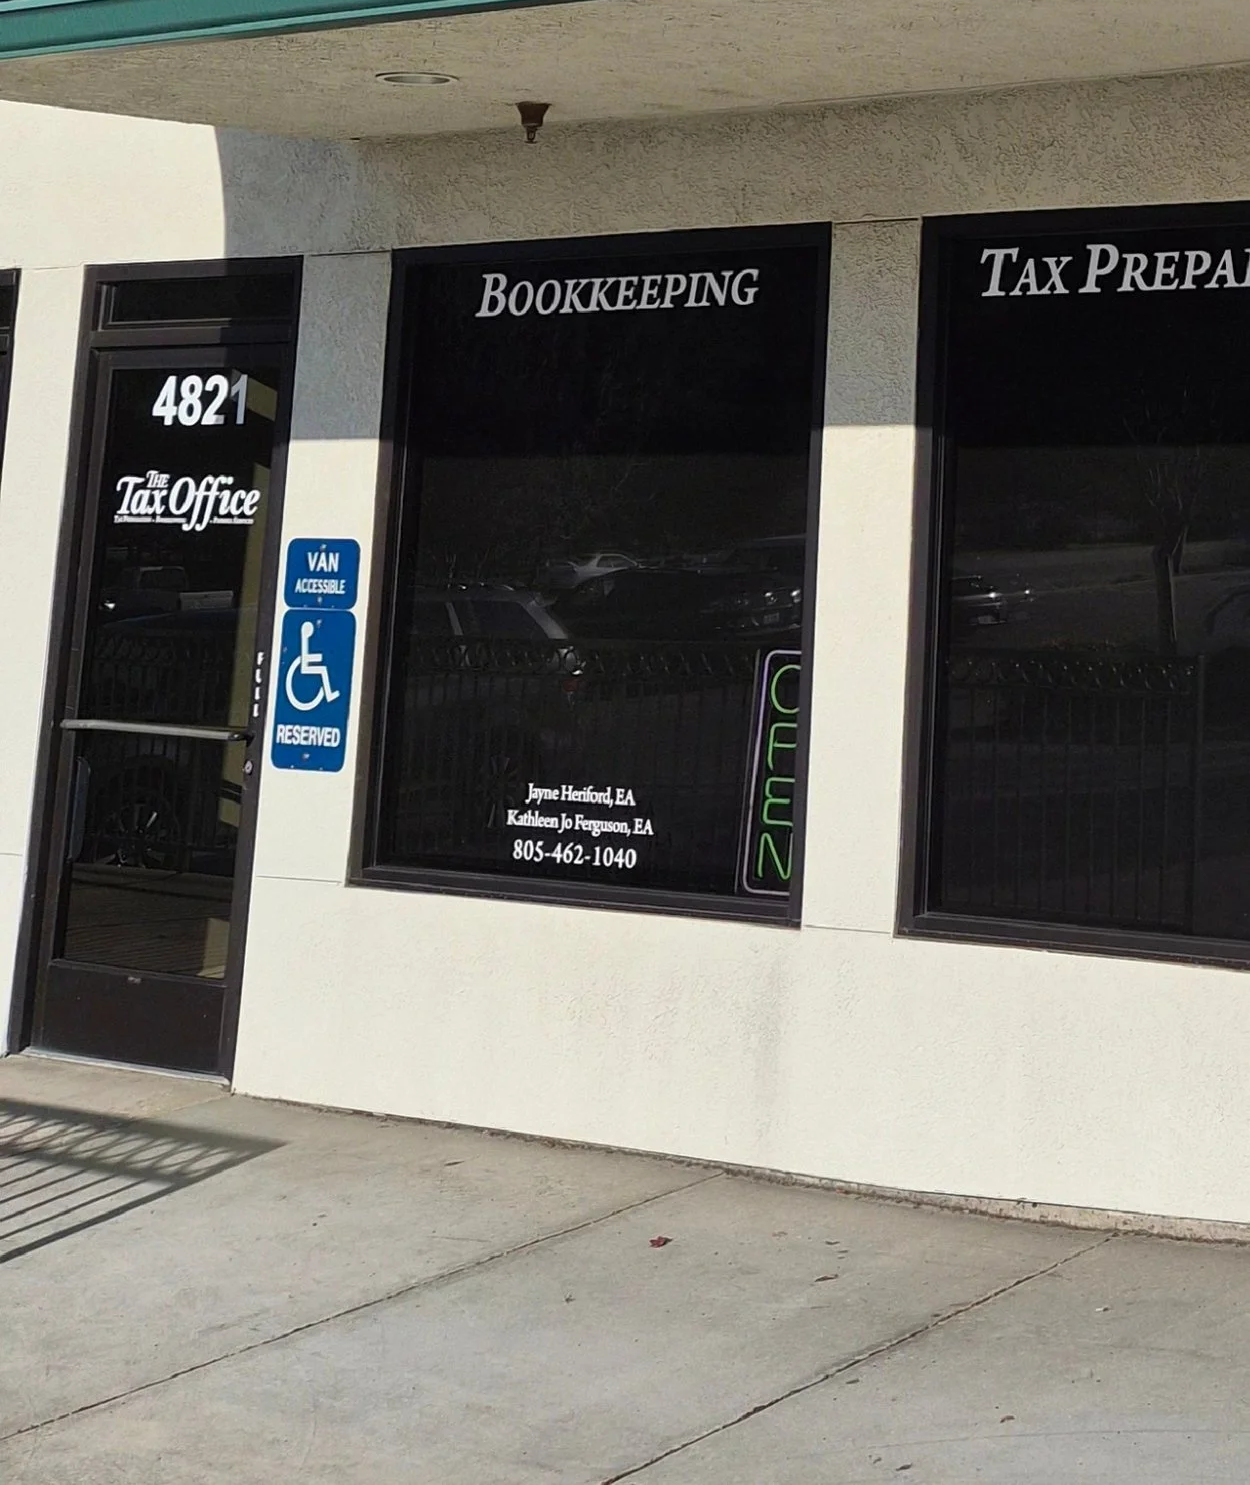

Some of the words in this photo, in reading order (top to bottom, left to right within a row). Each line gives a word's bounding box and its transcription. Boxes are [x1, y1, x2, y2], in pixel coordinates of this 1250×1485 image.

[980, 246, 1074, 297] TAX
[475, 268, 760, 317] BOOKKEEPING
[151, 374, 248, 427] 4821
[145, 469, 171, 489] THE
[115, 475, 168, 515] Tax
[168, 474, 261, 532] Office
[307, 551, 339, 573] VAN
[294, 578, 346, 595] ACCESSIBLE
[276, 723, 341, 748] RESERVED
[525, 782, 560, 806] Jayne
[560, 784, 614, 809] Heriford,
[614, 787, 636, 807] EA
[506, 809, 559, 829] Kathleen
[557, 813, 573, 834] Jo
[574, 814, 631, 838] Ferguson,
[632, 818, 654, 836] EA
[512, 838, 638, 869] 805-462-1040
